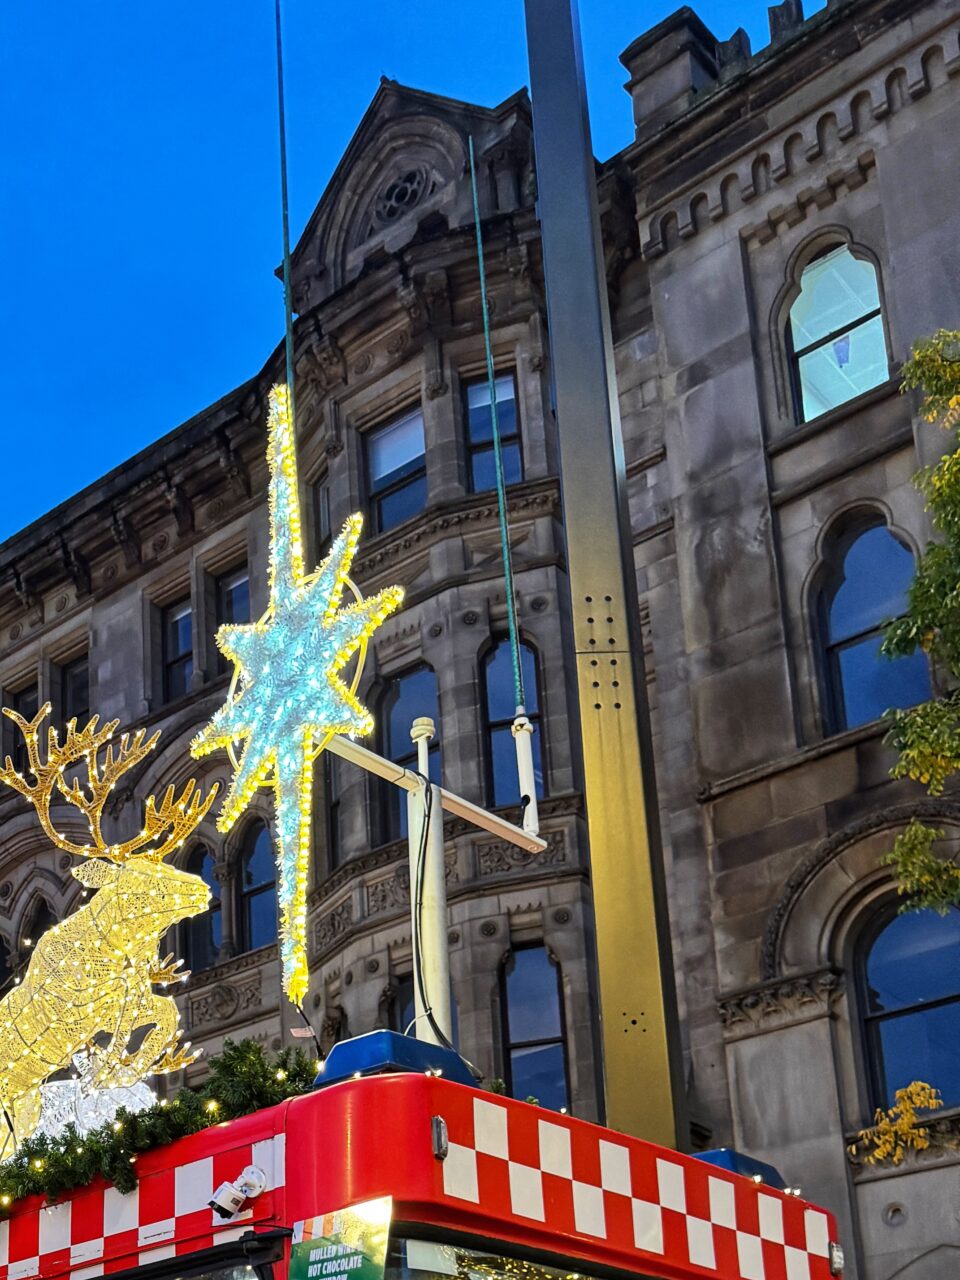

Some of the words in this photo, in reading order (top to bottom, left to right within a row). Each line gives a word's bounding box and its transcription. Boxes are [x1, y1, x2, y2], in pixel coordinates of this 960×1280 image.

[309, 1245, 337, 1262] MULLED
[308, 1263, 321, 1278] HOT
[322, 1255, 363, 1275] CHOCOLATE
